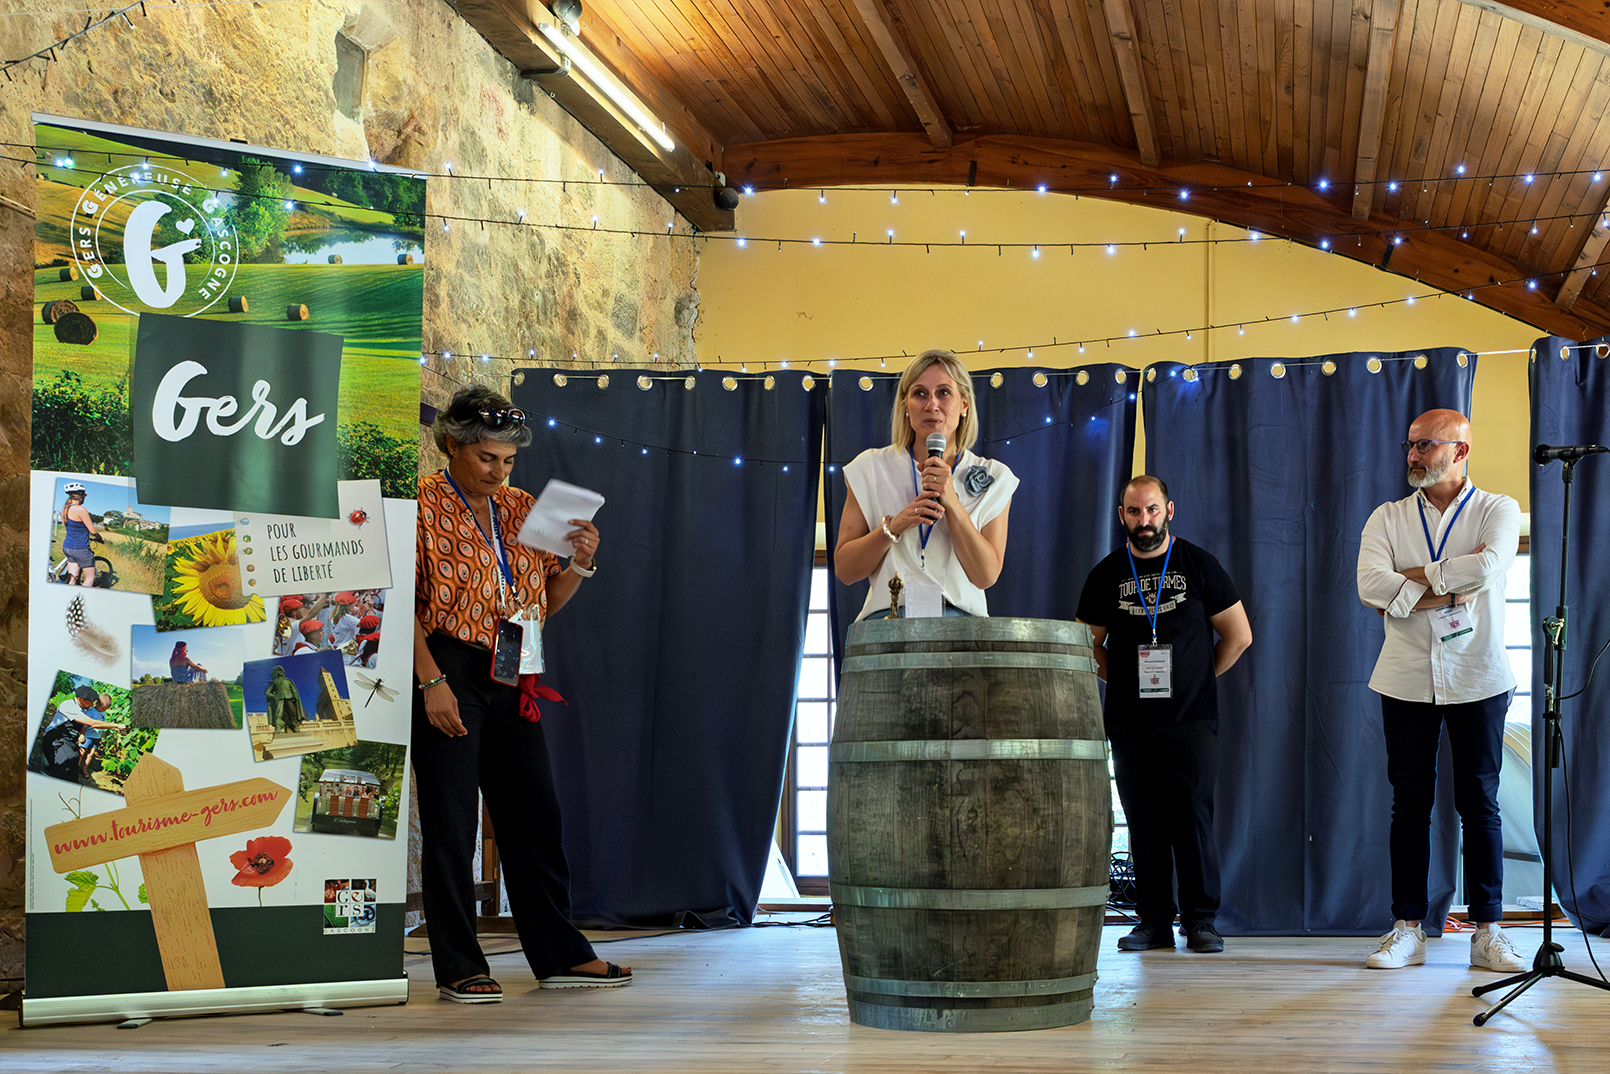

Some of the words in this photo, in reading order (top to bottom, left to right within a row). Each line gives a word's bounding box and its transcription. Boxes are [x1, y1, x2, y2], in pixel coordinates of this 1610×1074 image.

[79, 227, 103, 278] GERS
[198, 199, 231, 300] GASCOGNE
[152, 360, 325, 446] Gers
[267, 522, 297, 540] POUR
[270, 545, 288, 562] LES
[292, 539, 365, 560] GOURMANDS
[273, 568, 287, 584] DE
[291, 560, 334, 582] LIBERTÉ
[1140, 577, 1152, 593] DE
[54, 790, 279, 855] www.tourisme-gers.com
